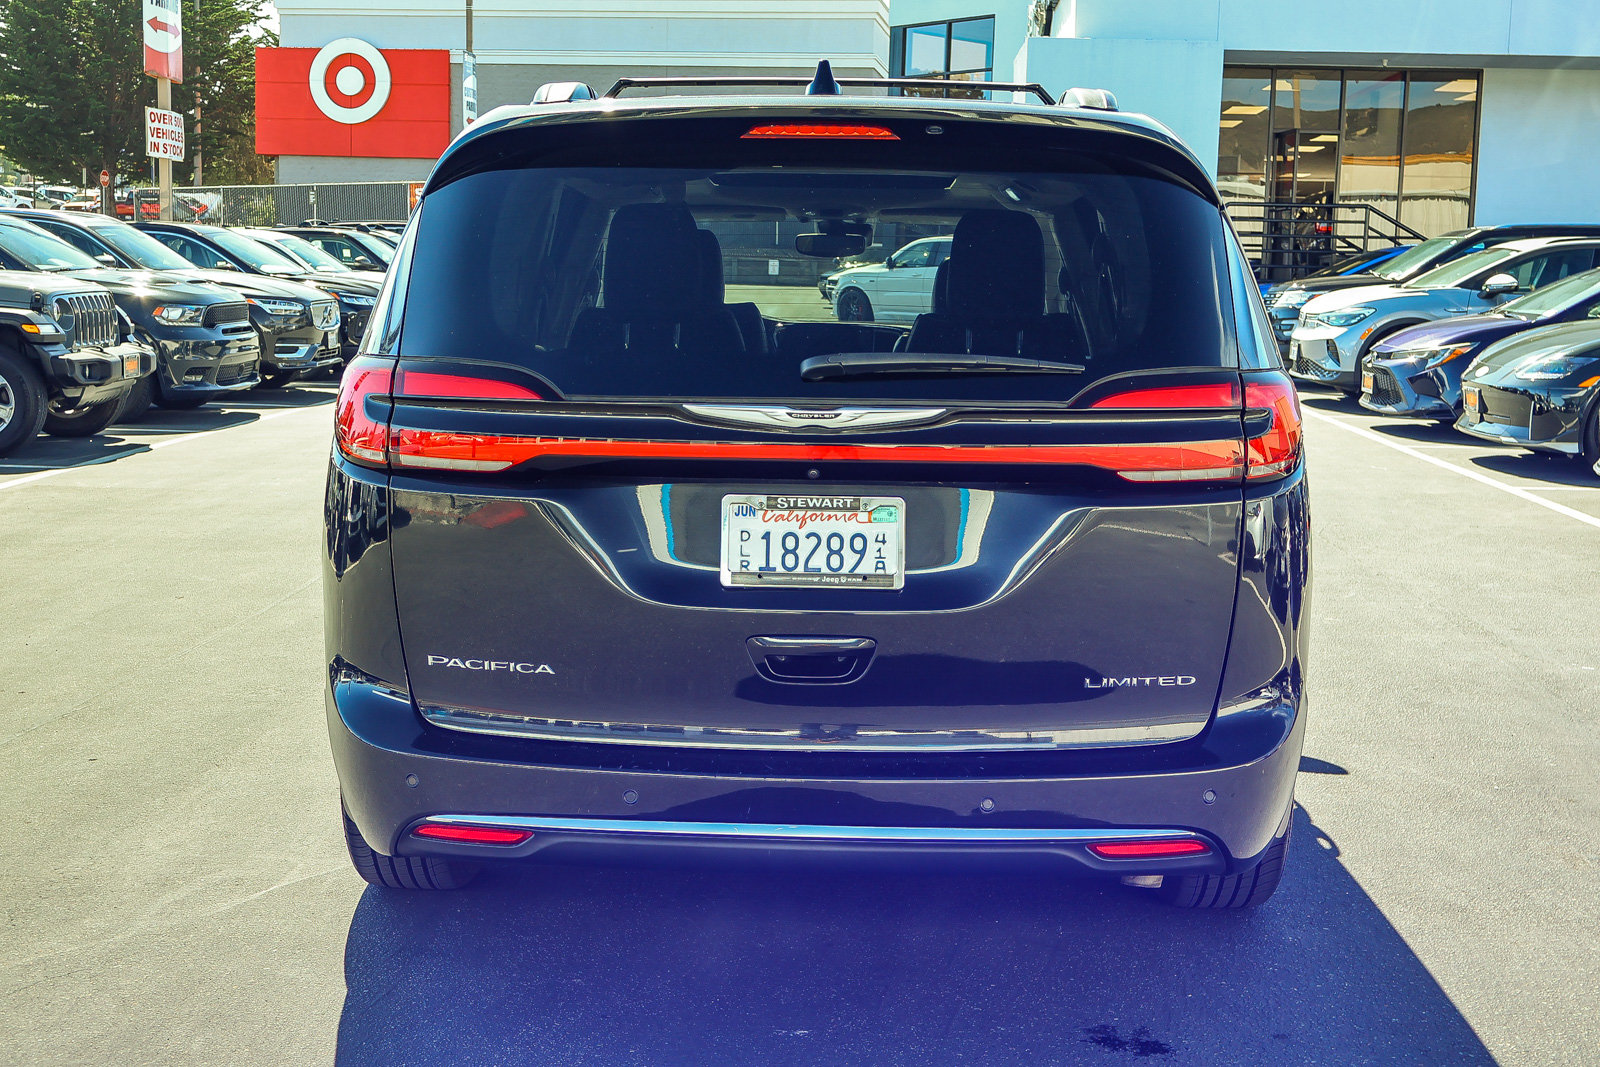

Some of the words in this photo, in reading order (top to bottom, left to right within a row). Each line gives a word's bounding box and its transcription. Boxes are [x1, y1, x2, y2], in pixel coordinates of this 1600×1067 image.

[149, 111, 173, 126] OVER
[149, 126, 184, 144] VEHICLES
[150, 141, 160, 153] IN
[162, 143, 183, 158] STOCK
[777, 497, 854, 508] STEWART
[734, 505, 757, 517] JUN
[762, 509, 872, 530] California
[758, 531, 868, 574] 18289
[821, 576, 840, 584] Jeep
[427, 655, 555, 675] PACIFICA
[1084, 676, 1196, 688] LIMITED
